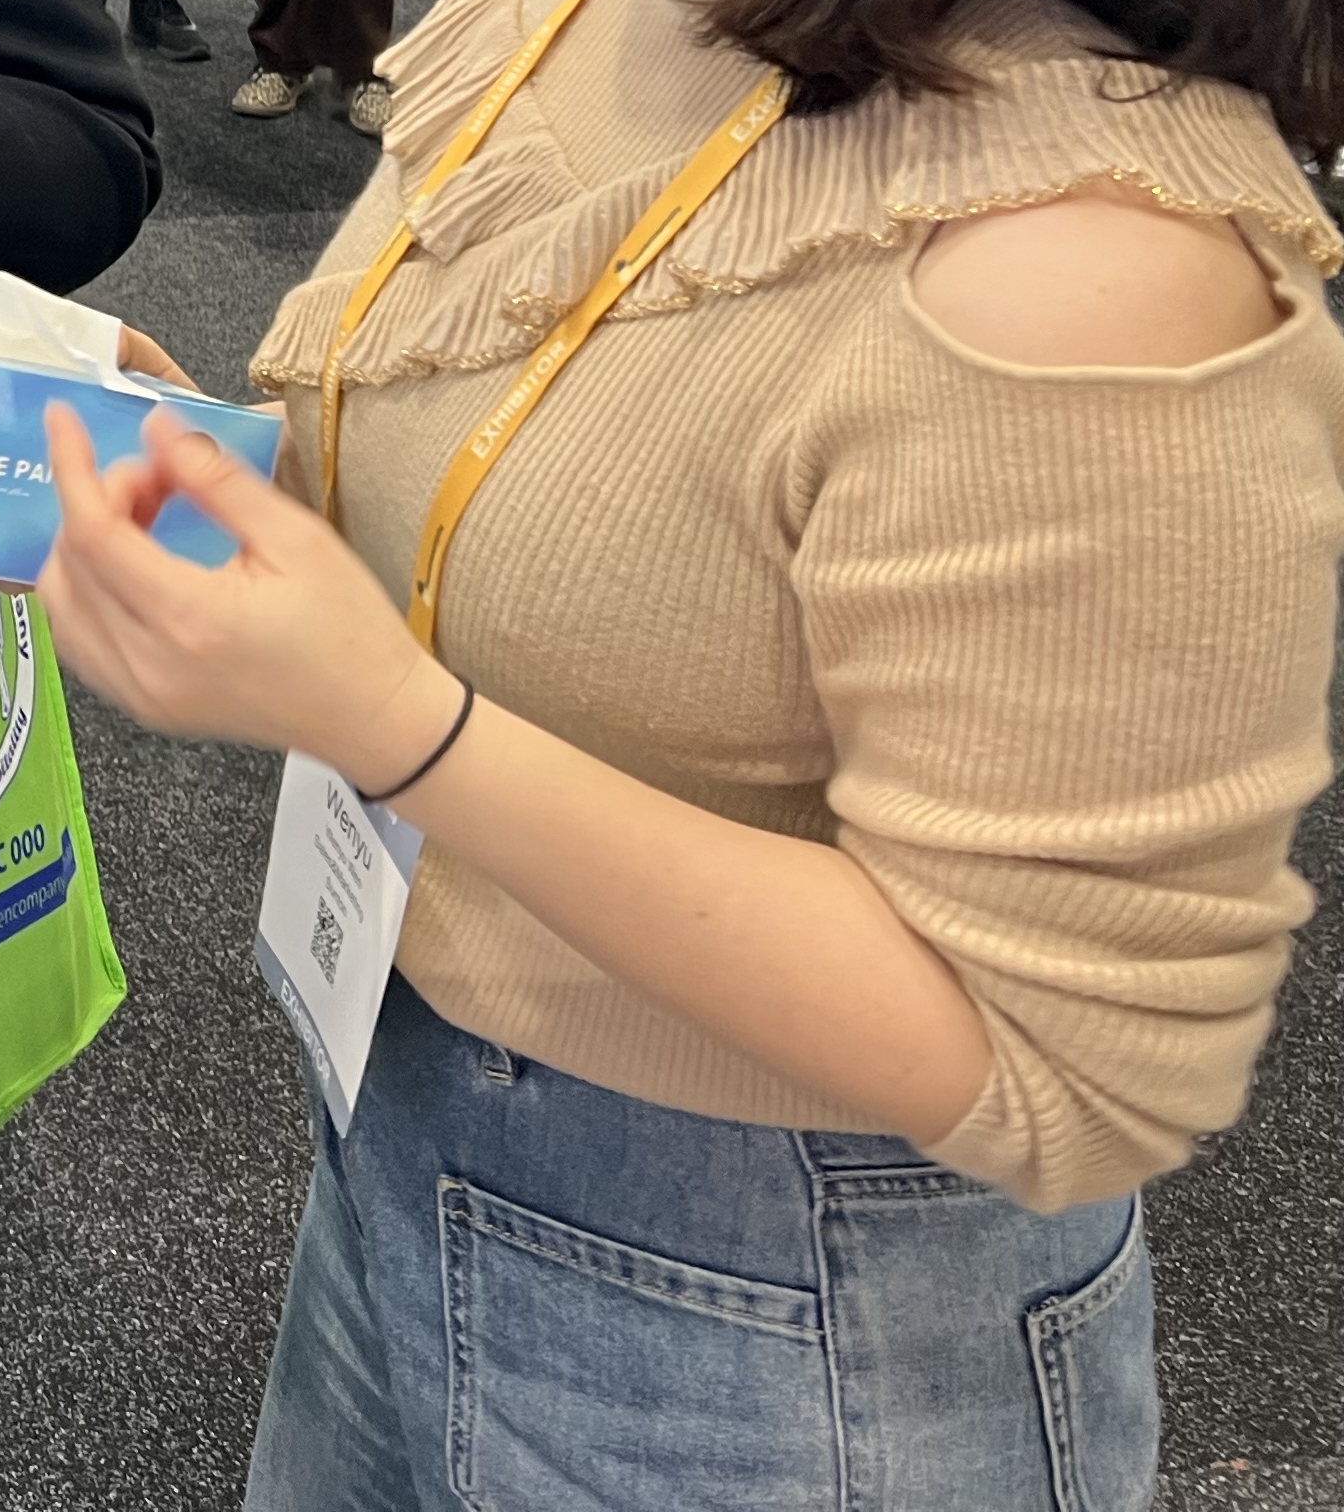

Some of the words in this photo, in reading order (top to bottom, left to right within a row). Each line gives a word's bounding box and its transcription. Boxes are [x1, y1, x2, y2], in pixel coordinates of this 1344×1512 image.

[470, 341, 567, 460] EXHIBITOR
[10, 824, 46, 865] 000
[325, 780, 373, 872] Wenyu
